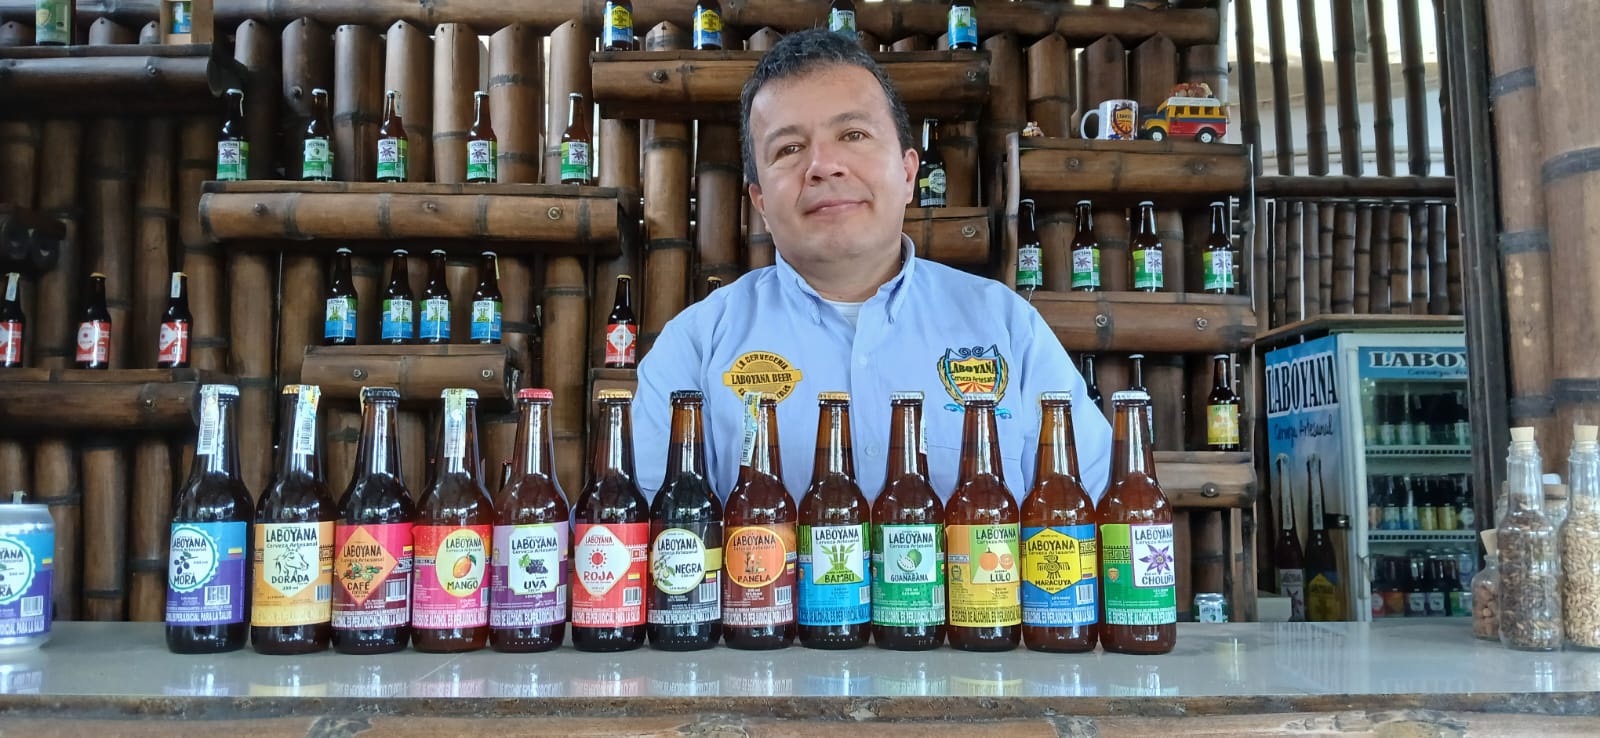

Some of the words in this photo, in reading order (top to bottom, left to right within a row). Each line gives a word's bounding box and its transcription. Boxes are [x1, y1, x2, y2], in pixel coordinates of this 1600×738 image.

[731, 373, 771, 385] LABOYANA
[772, 372, 793, 382] BEER
[1266, 355, 1338, 414] LABOYANA
[265, 528, 318, 543] LABOYANA
[816, 528, 859, 541] LABOYANA
[889, 533, 934, 545] LABOYANA
[976, 528, 1017, 540] LABOYANA
[446, 538, 482, 549] LABOYANA
[512, 537, 558, 550] LABOYANA
[658, 538, 698, 551] LABOYANA
[734, 536, 777, 547] LABOYANA
[1028, 540, 1076, 552] LABOYANA
[343, 545, 382, 558] LABOYANA
[675, 563, 703, 574] NEGRA
[174, 574, 197, 585] MORA
[271, 574, 310, 584] DORADA
[584, 571, 615, 581] ROJA
[738, 574, 772, 583] PANELA
[990, 572, 1011, 582] LULO
[447, 580, 478, 590] MANGO
[524, 580, 547, 590] UVA
